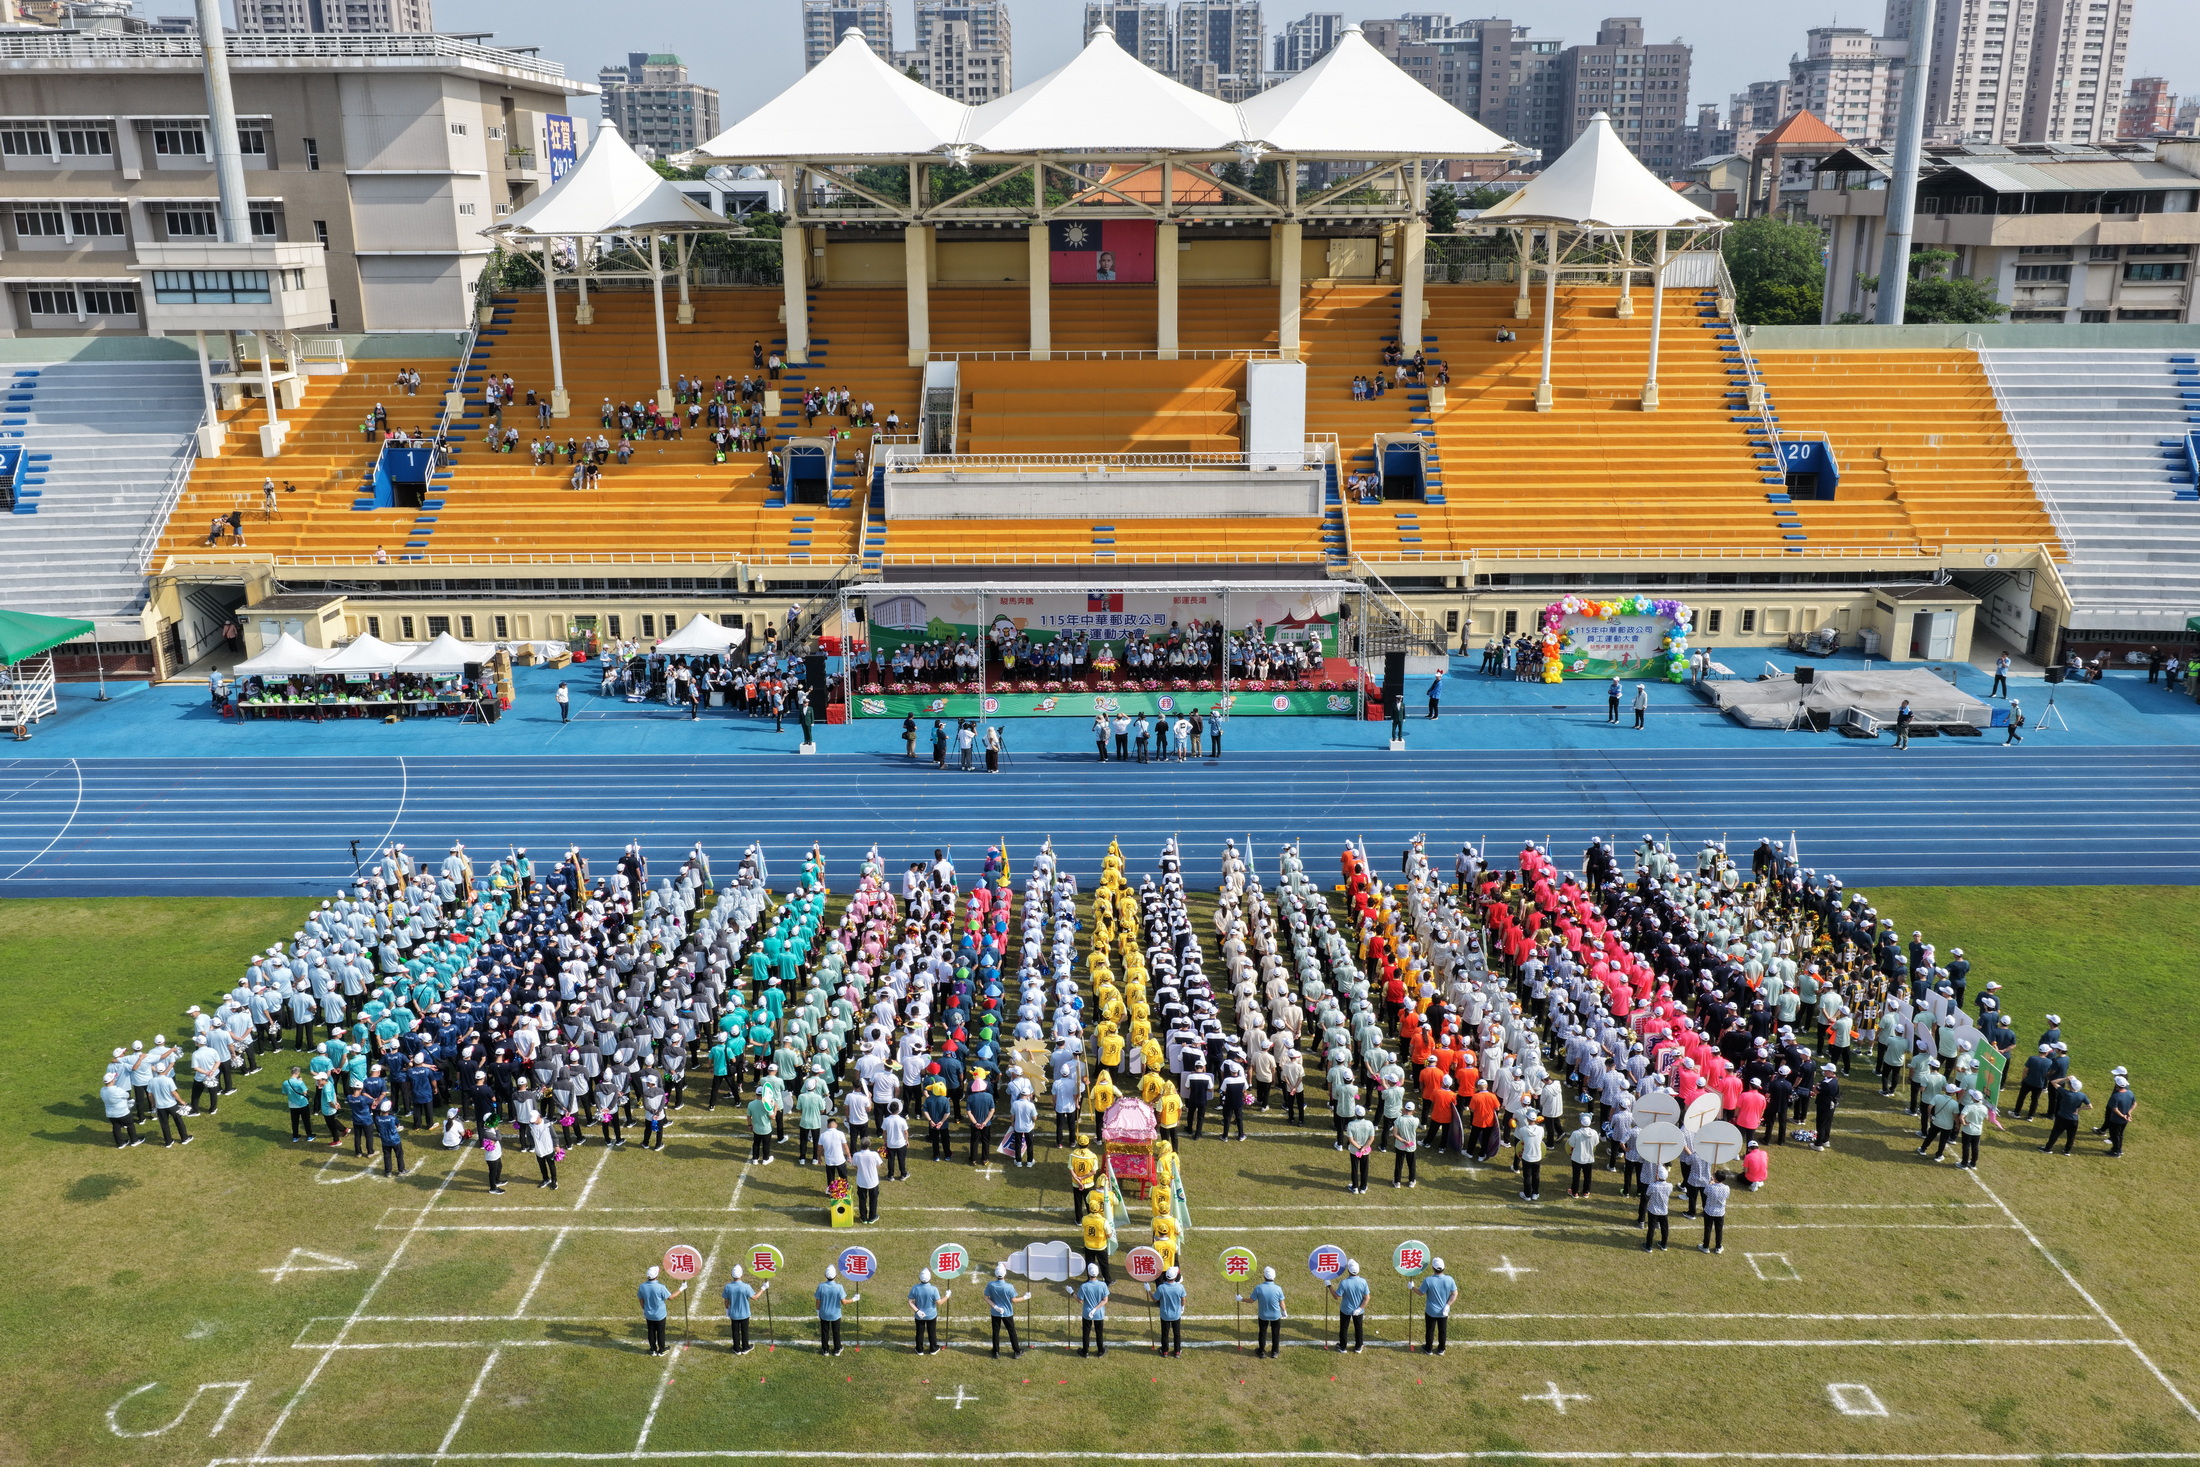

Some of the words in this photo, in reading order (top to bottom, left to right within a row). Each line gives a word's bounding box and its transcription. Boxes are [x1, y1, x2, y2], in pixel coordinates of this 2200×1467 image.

[549, 119, 572, 151] 狂賀
[407, 451, 414, 467] 1
[1788, 444, 1811, 460] 20
[1040, 613, 1167, 627] 115年中華郵政公司
[1575, 626, 1653, 634] 115年中華郵政公司
[1587, 635, 1640, 643] 員工運動大會
[671, 1253, 695, 1273] 鴻
[752, 1252, 776, 1273] 長
[846, 1254, 869, 1275] 運
[937, 1251, 961, 1273] 郵
[1133, 1255, 1156, 1276] 騰
[1226, 1255, 1249, 1276] 奔
[1317, 1252, 1341, 1273] 馬
[1400, 1248, 1423, 1269] 駿
